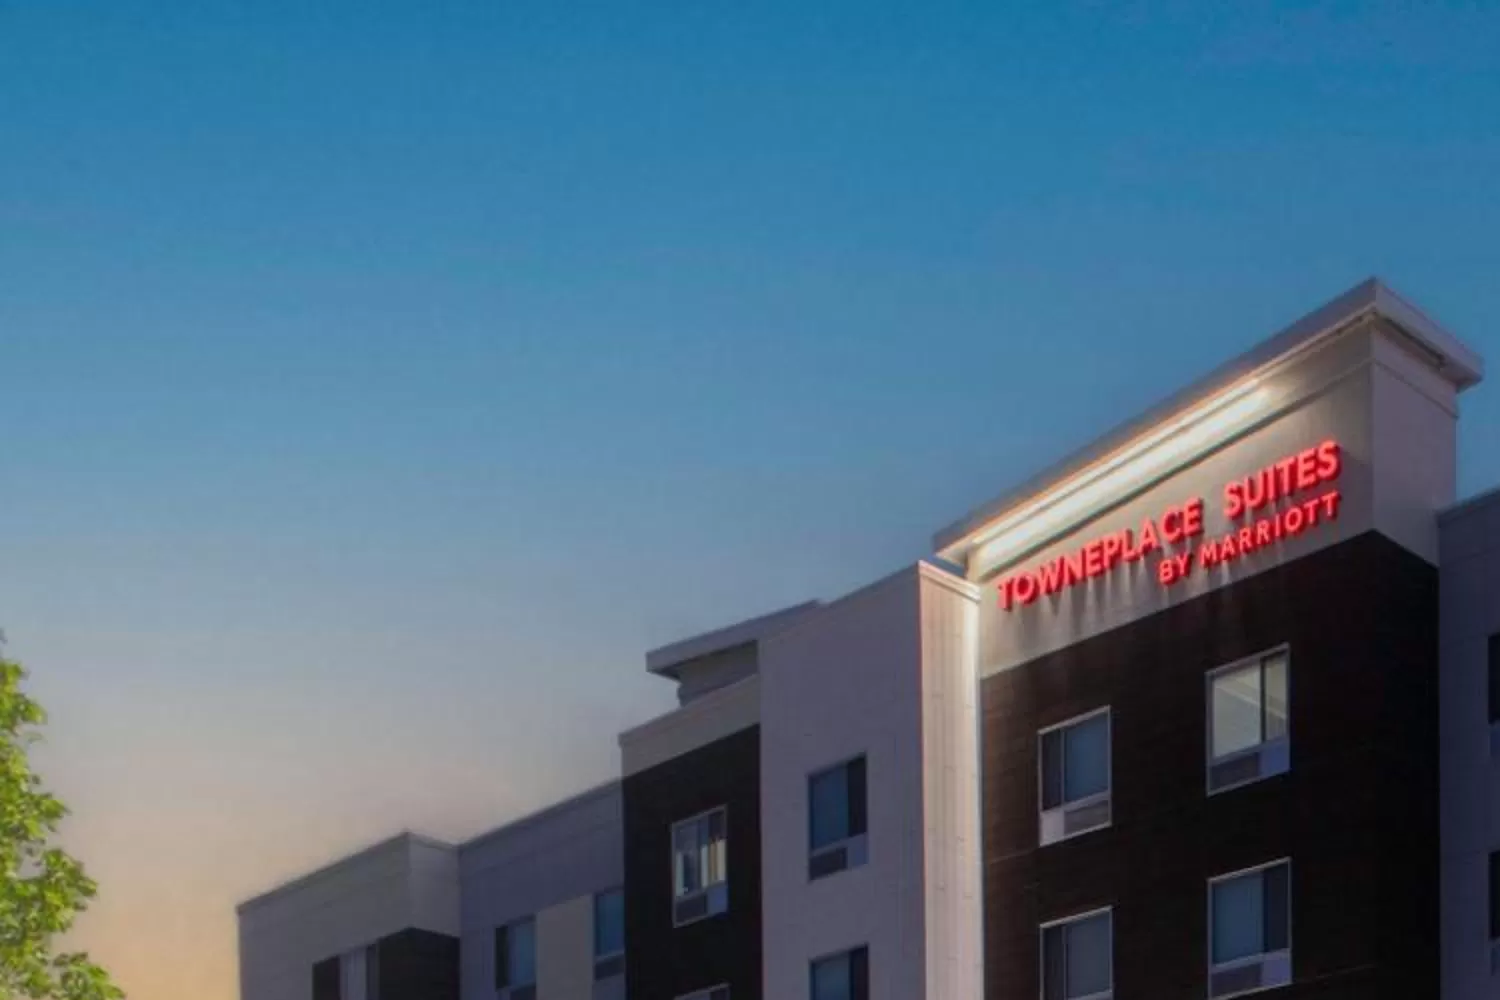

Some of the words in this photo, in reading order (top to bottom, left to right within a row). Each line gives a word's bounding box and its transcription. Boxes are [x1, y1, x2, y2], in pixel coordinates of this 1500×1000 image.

[997, 498, 1204, 611] TOWNEPLACE
[1223, 440, 1341, 519] SUITES
[1159, 552, 1193, 586] BY
[1200, 491, 1341, 568] MARRIOTT
